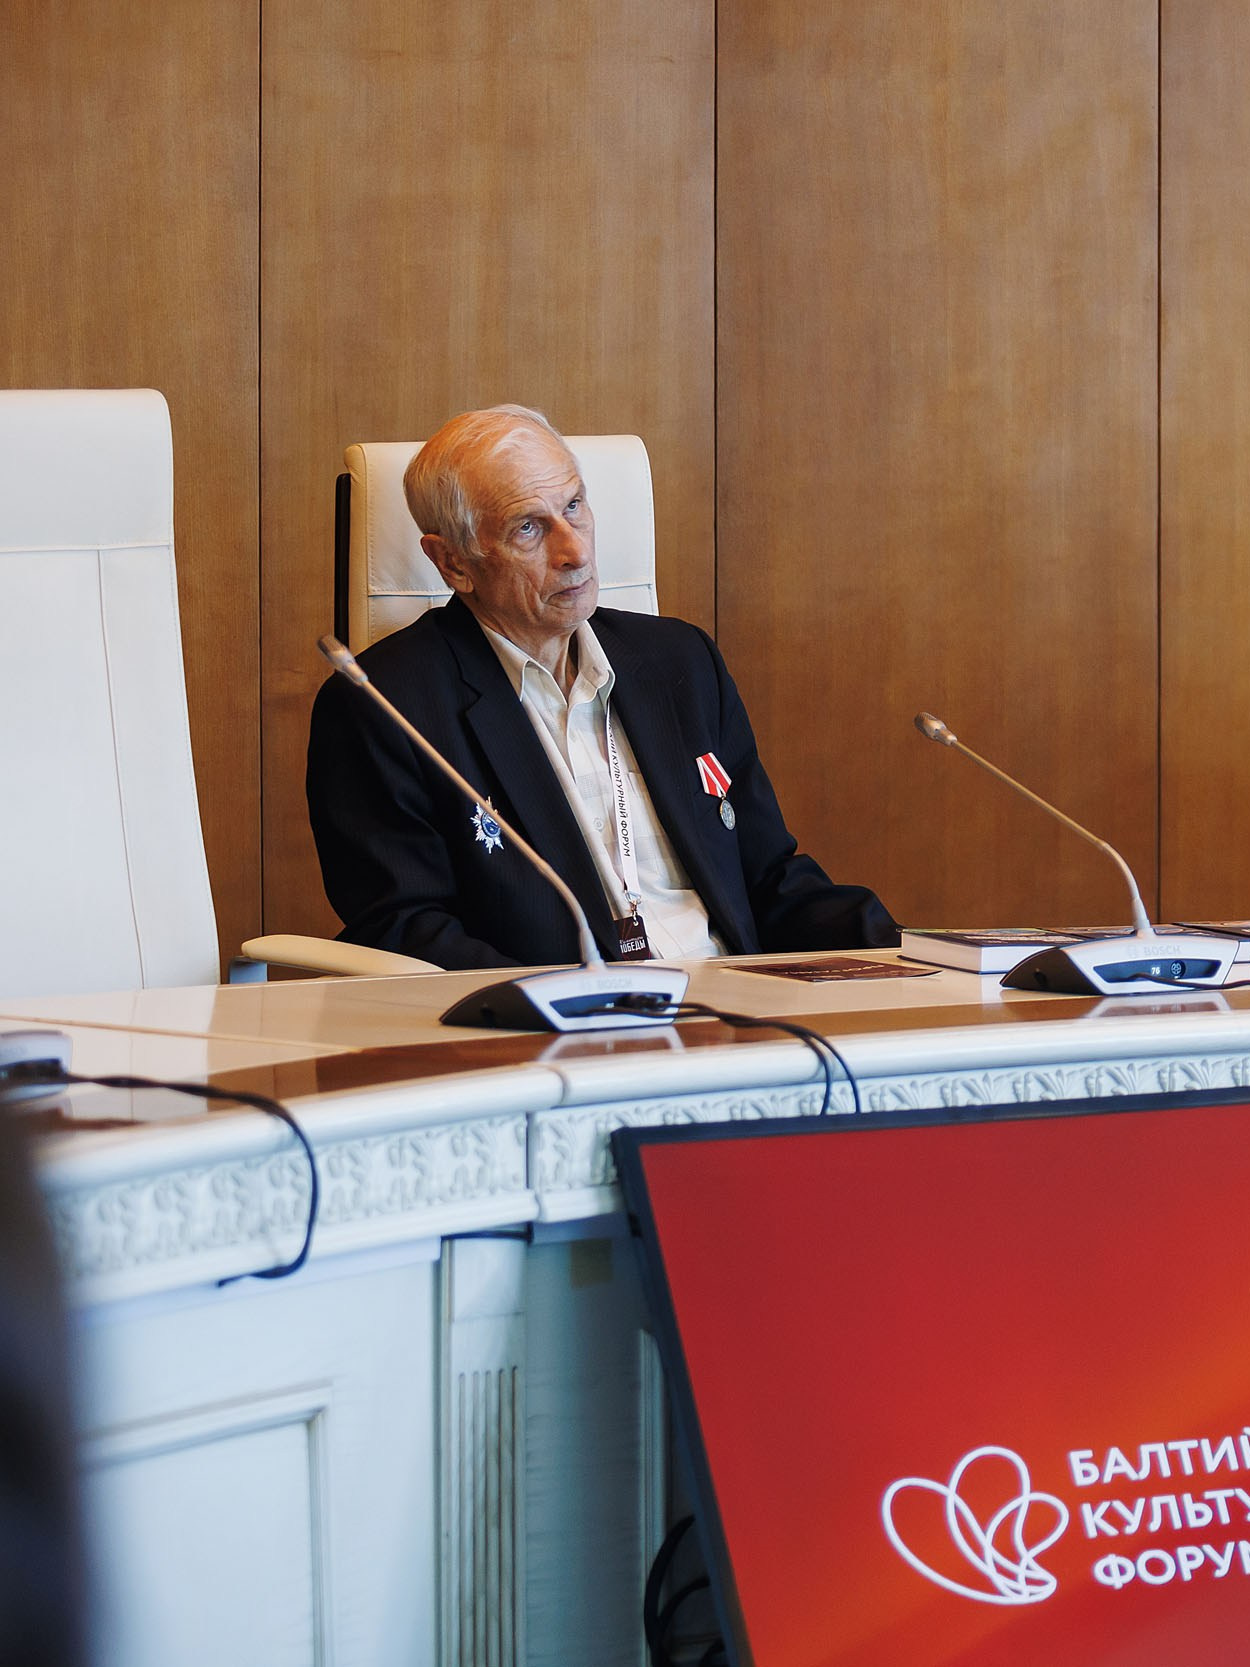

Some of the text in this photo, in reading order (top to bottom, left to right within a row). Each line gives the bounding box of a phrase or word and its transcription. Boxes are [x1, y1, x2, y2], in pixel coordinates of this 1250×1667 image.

[611, 755, 629, 818] КУЛЬТУРНЫЙ
[618, 819, 631, 857] ФОРУМ
[1143, 944, 1181, 956] BOSCH
